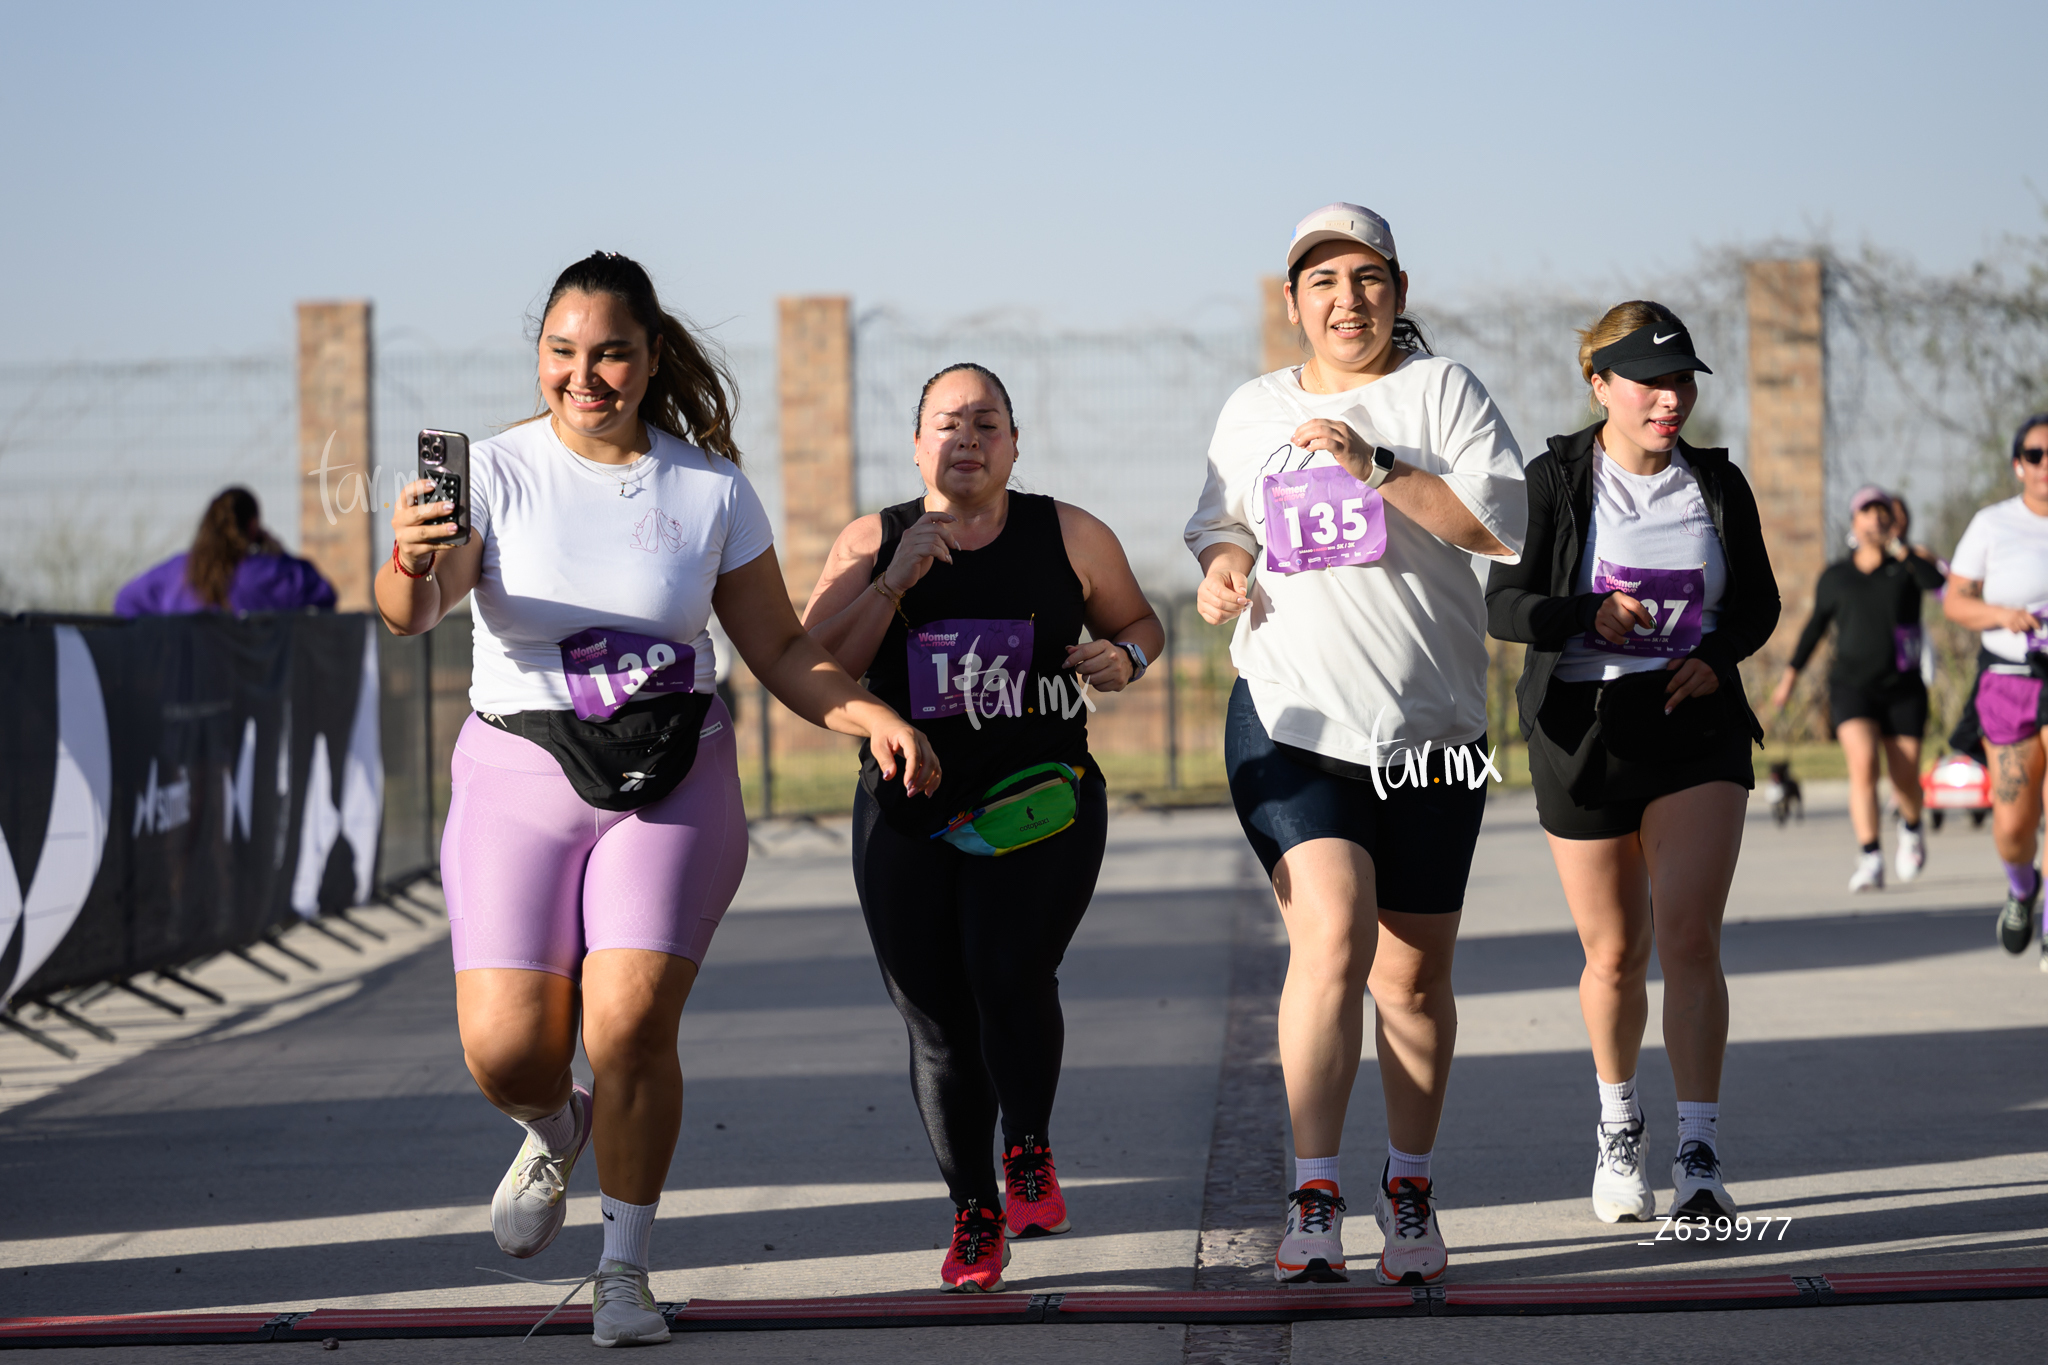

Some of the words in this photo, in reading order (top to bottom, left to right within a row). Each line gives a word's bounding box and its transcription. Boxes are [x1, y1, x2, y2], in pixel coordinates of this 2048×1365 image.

[1284, 498, 1367, 548] 135
[1633, 598, 1689, 636] 37
[932, 652, 1009, 694] 136
[1019, 818, 1050, 832] cotopaxi
